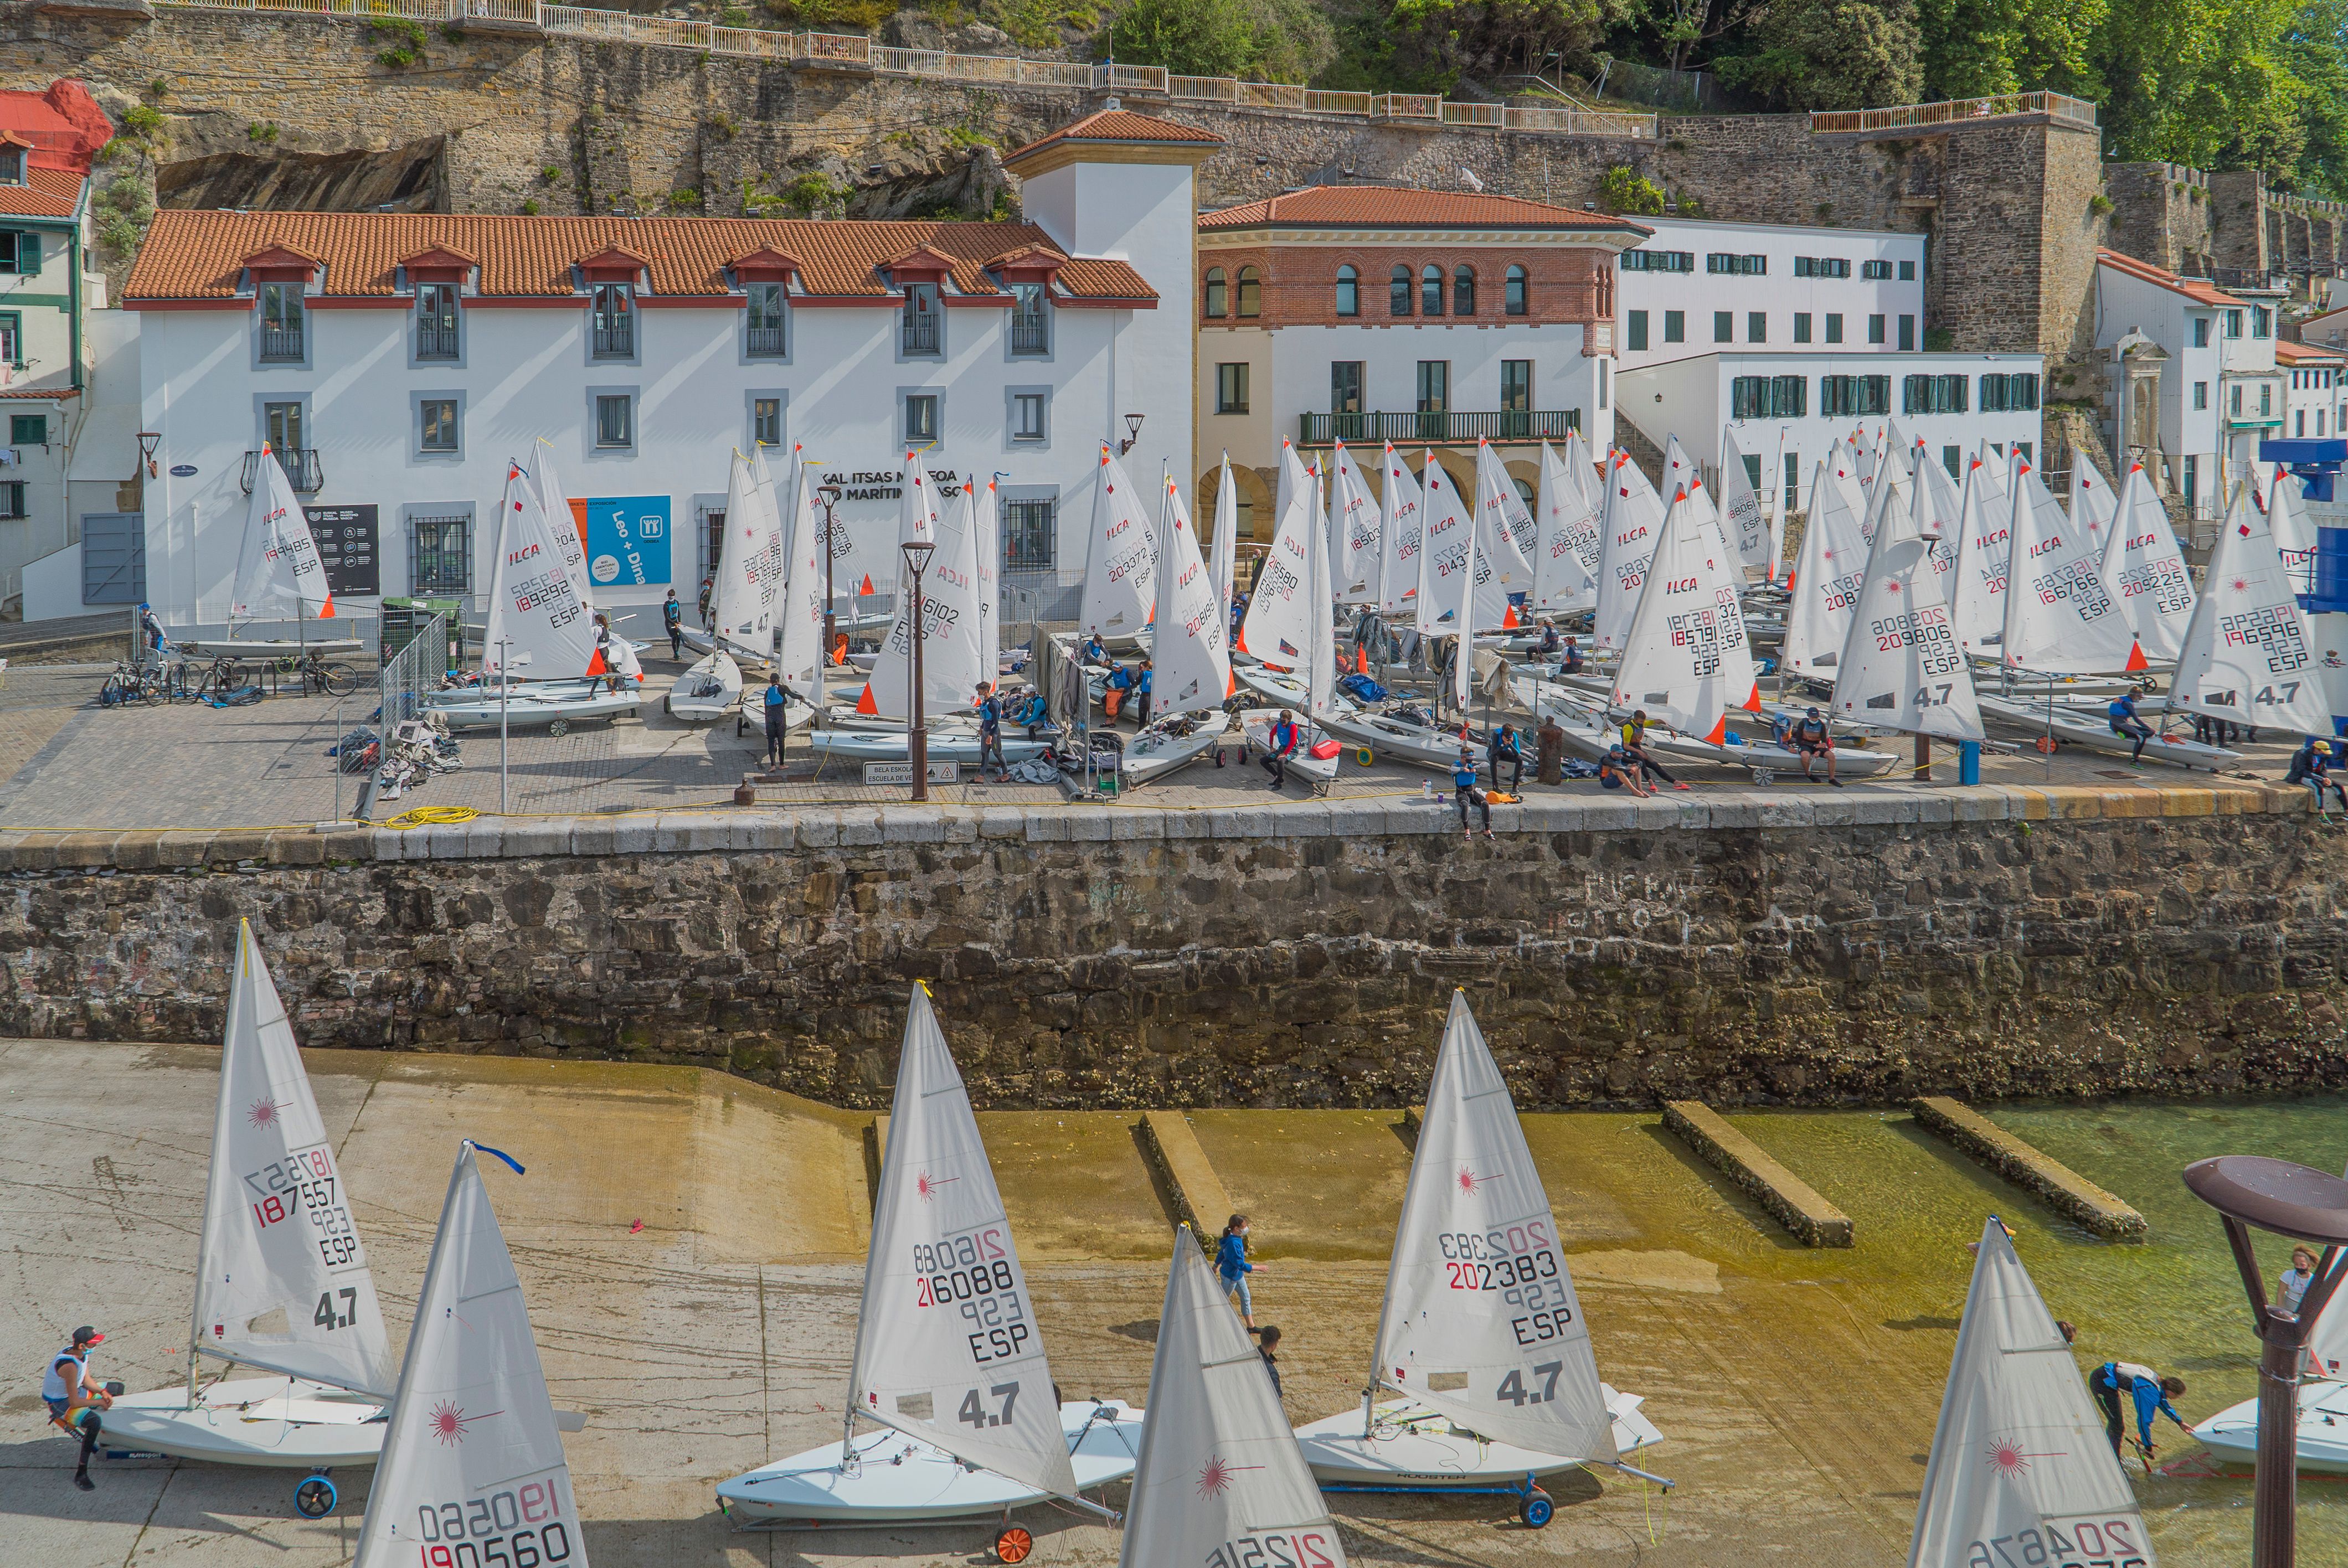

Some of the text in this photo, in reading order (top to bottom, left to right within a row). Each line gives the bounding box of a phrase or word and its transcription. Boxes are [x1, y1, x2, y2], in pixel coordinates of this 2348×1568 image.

[853, 472, 893, 483] ITSAS
[1345, 498, 1363, 516] ILCA
[1396, 502, 1415, 522] ILCA
[1487, 493, 1507, 510] ILCA
[264, 508, 286, 525] ILCA
[1430, 517, 1455, 538] ILCA
[1743, 517, 1761, 532] ESP
[1106, 519, 1129, 541] ILCA
[1351, 526, 1381, 551] 18503
[1618, 527, 1647, 546] ILCA
[1977, 529, 2009, 550] ILCA
[266, 538, 310, 562] 199485
[612, 510, 628, 538] Leo
[627, 552, 646, 585] Dina
[831, 542, 852, 559] ESP
[1399, 539, 1420, 560] 205
[1551, 529, 1597, 558] 209224
[1741, 534, 1759, 552] 4.7
[2030, 536, 2062, 559] ILCA
[2126, 534, 2155, 552] ILCA
[509, 544, 540, 566] ILCA
[1109, 548, 1147, 582] 203372
[292, 559, 317, 576] ESP
[747, 561, 770, 585] 195765
[1135, 568, 1150, 589] ESP
[1180, 563, 1198, 590] ILCA
[1268, 555, 1297, 589] 216580
[1260, 578, 1274, 598] ESP
[1667, 577, 1697, 595] ILCA
[2039, 572, 2098, 605] 166766
[2122, 571, 2184, 597] 209225
[516, 580, 570, 612] 189292
[761, 588, 771, 605] ESP
[1825, 588, 1860, 611] 208
[2158, 596, 2191, 613] ESP
[550, 606, 579, 628] ESP
[1186, 597, 1214, 637] 208195
[2078, 599, 2110, 621] ESP
[758, 612, 769, 633] 4.7
[1208, 624, 1220, 650] ESP
[1671, 626, 1717, 646] 185791
[1877, 625, 1950, 651] 209806
[2225, 621, 2300, 647] 196596
[1694, 658, 1720, 676] ESP
[1923, 656, 1959, 674] ESP
[2268, 652, 2309, 673] ESP
[1913, 683, 1953, 708] 4.7
[2255, 682, 2300, 706] 4.7
[254, 1177, 334, 1229] 187557
[320, 1236, 356, 1267] ESP
[1446, 1250, 1558, 1291] 202383
[918, 1260, 1013, 1307] 216088
[315, 1287, 356, 1331] 4.7
[1511, 1308, 1572, 1345] ESP
[969, 1323, 1028, 1363] ESP
[1497, 1360, 1563, 1407] 4.7
[959, 1381, 1019, 1429] 4.7
